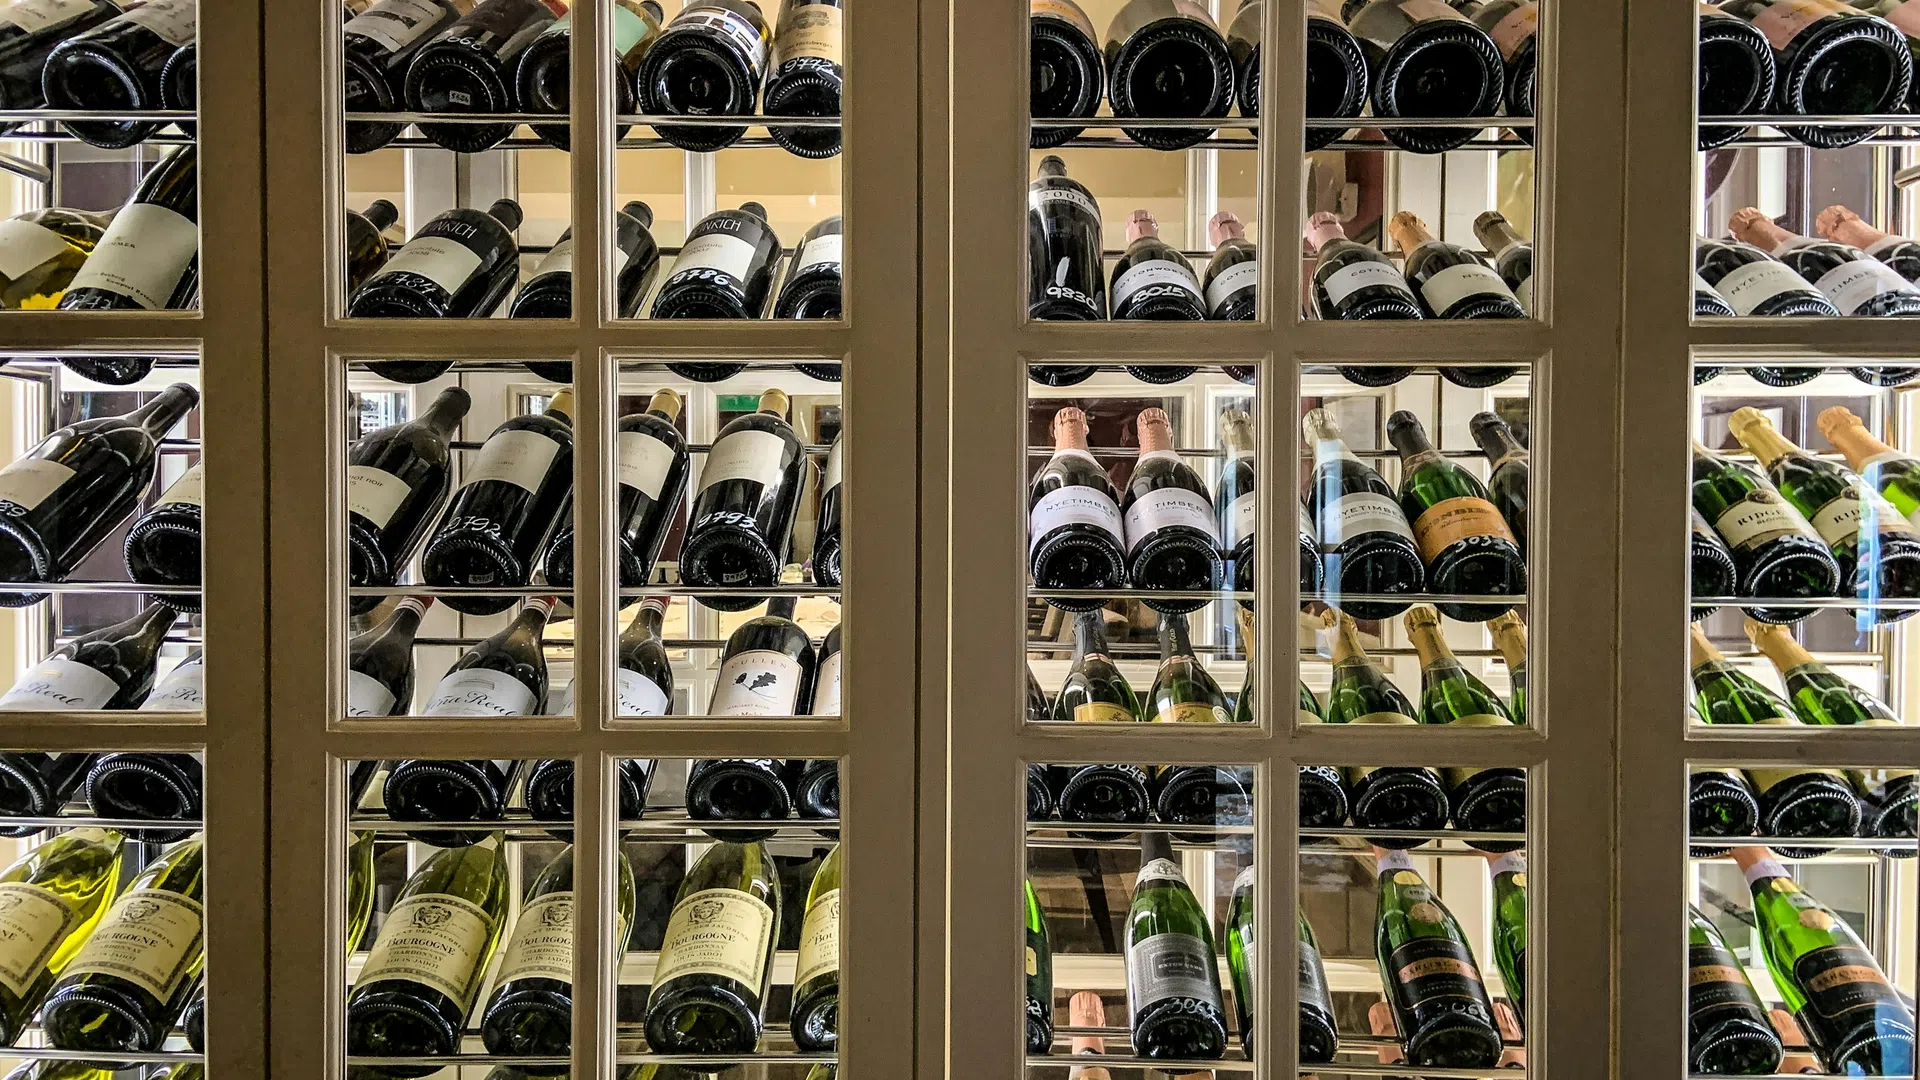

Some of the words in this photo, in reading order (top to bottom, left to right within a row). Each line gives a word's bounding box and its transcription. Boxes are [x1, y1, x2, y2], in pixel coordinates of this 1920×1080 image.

[1041, 191, 1086, 206] 2000
[672, 269, 731, 286] 9786
[1046, 498, 1116, 518] NYETIMBER
[731, 658, 787, 669] CULLEN
[386, 937, 456, 956] BOURGOGNE
[670, 932, 736, 950] BOURGOGNE
